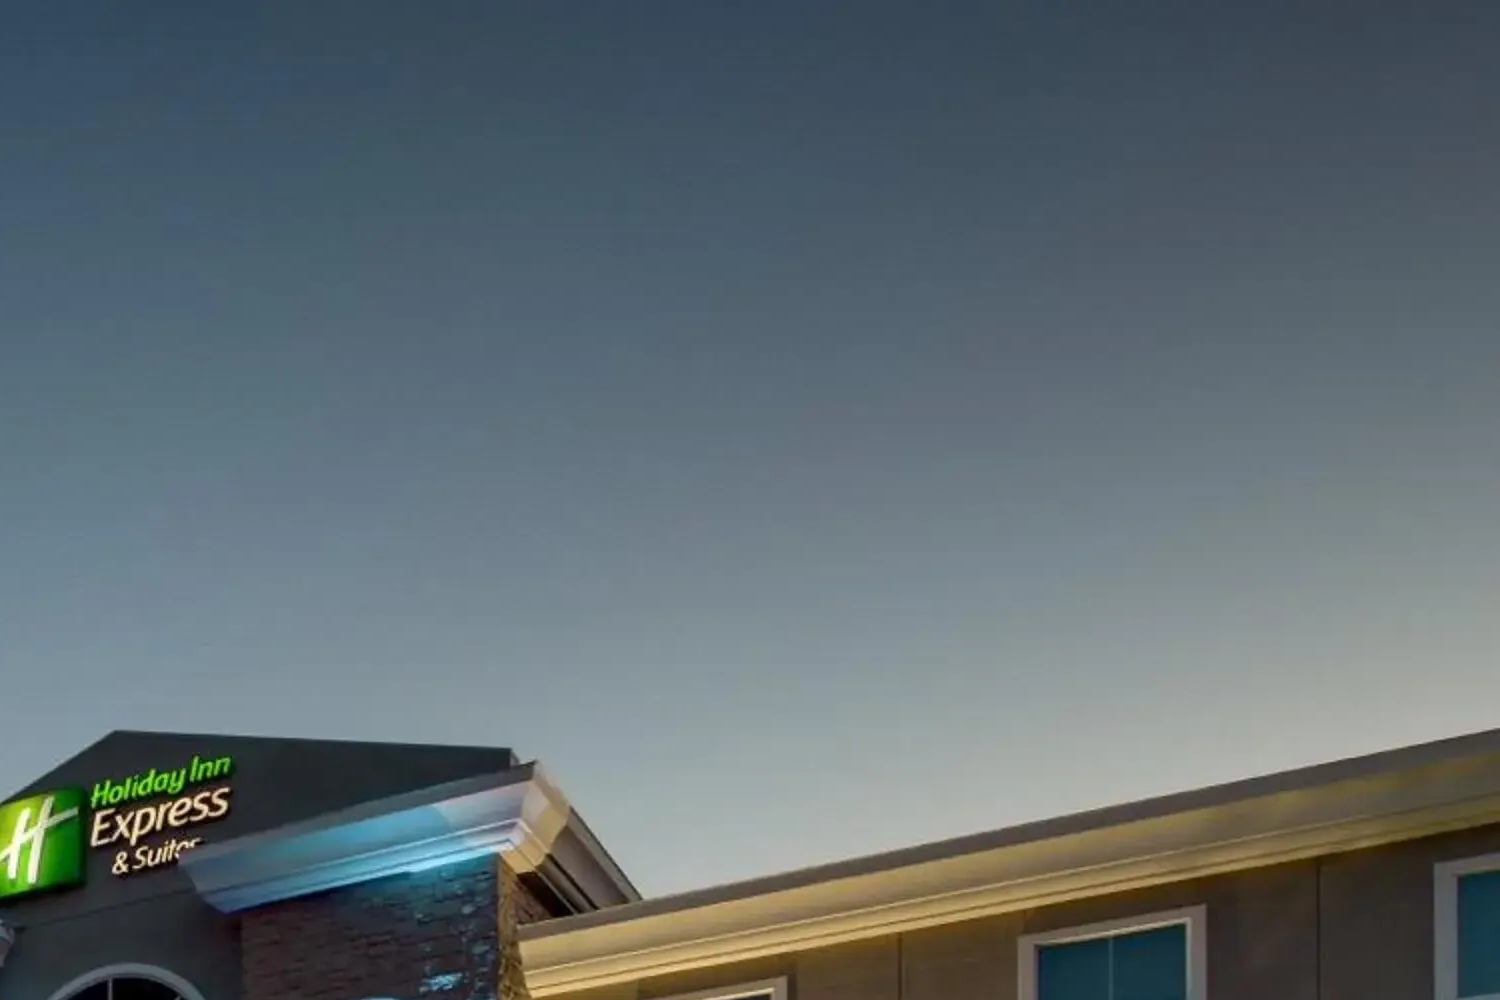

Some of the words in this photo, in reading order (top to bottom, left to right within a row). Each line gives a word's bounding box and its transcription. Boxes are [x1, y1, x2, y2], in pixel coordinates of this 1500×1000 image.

[91, 766, 186, 809] Holiday
[189, 754, 232, 783] Inn
[89, 786, 232, 847] Express
[111, 851, 129, 875] &
